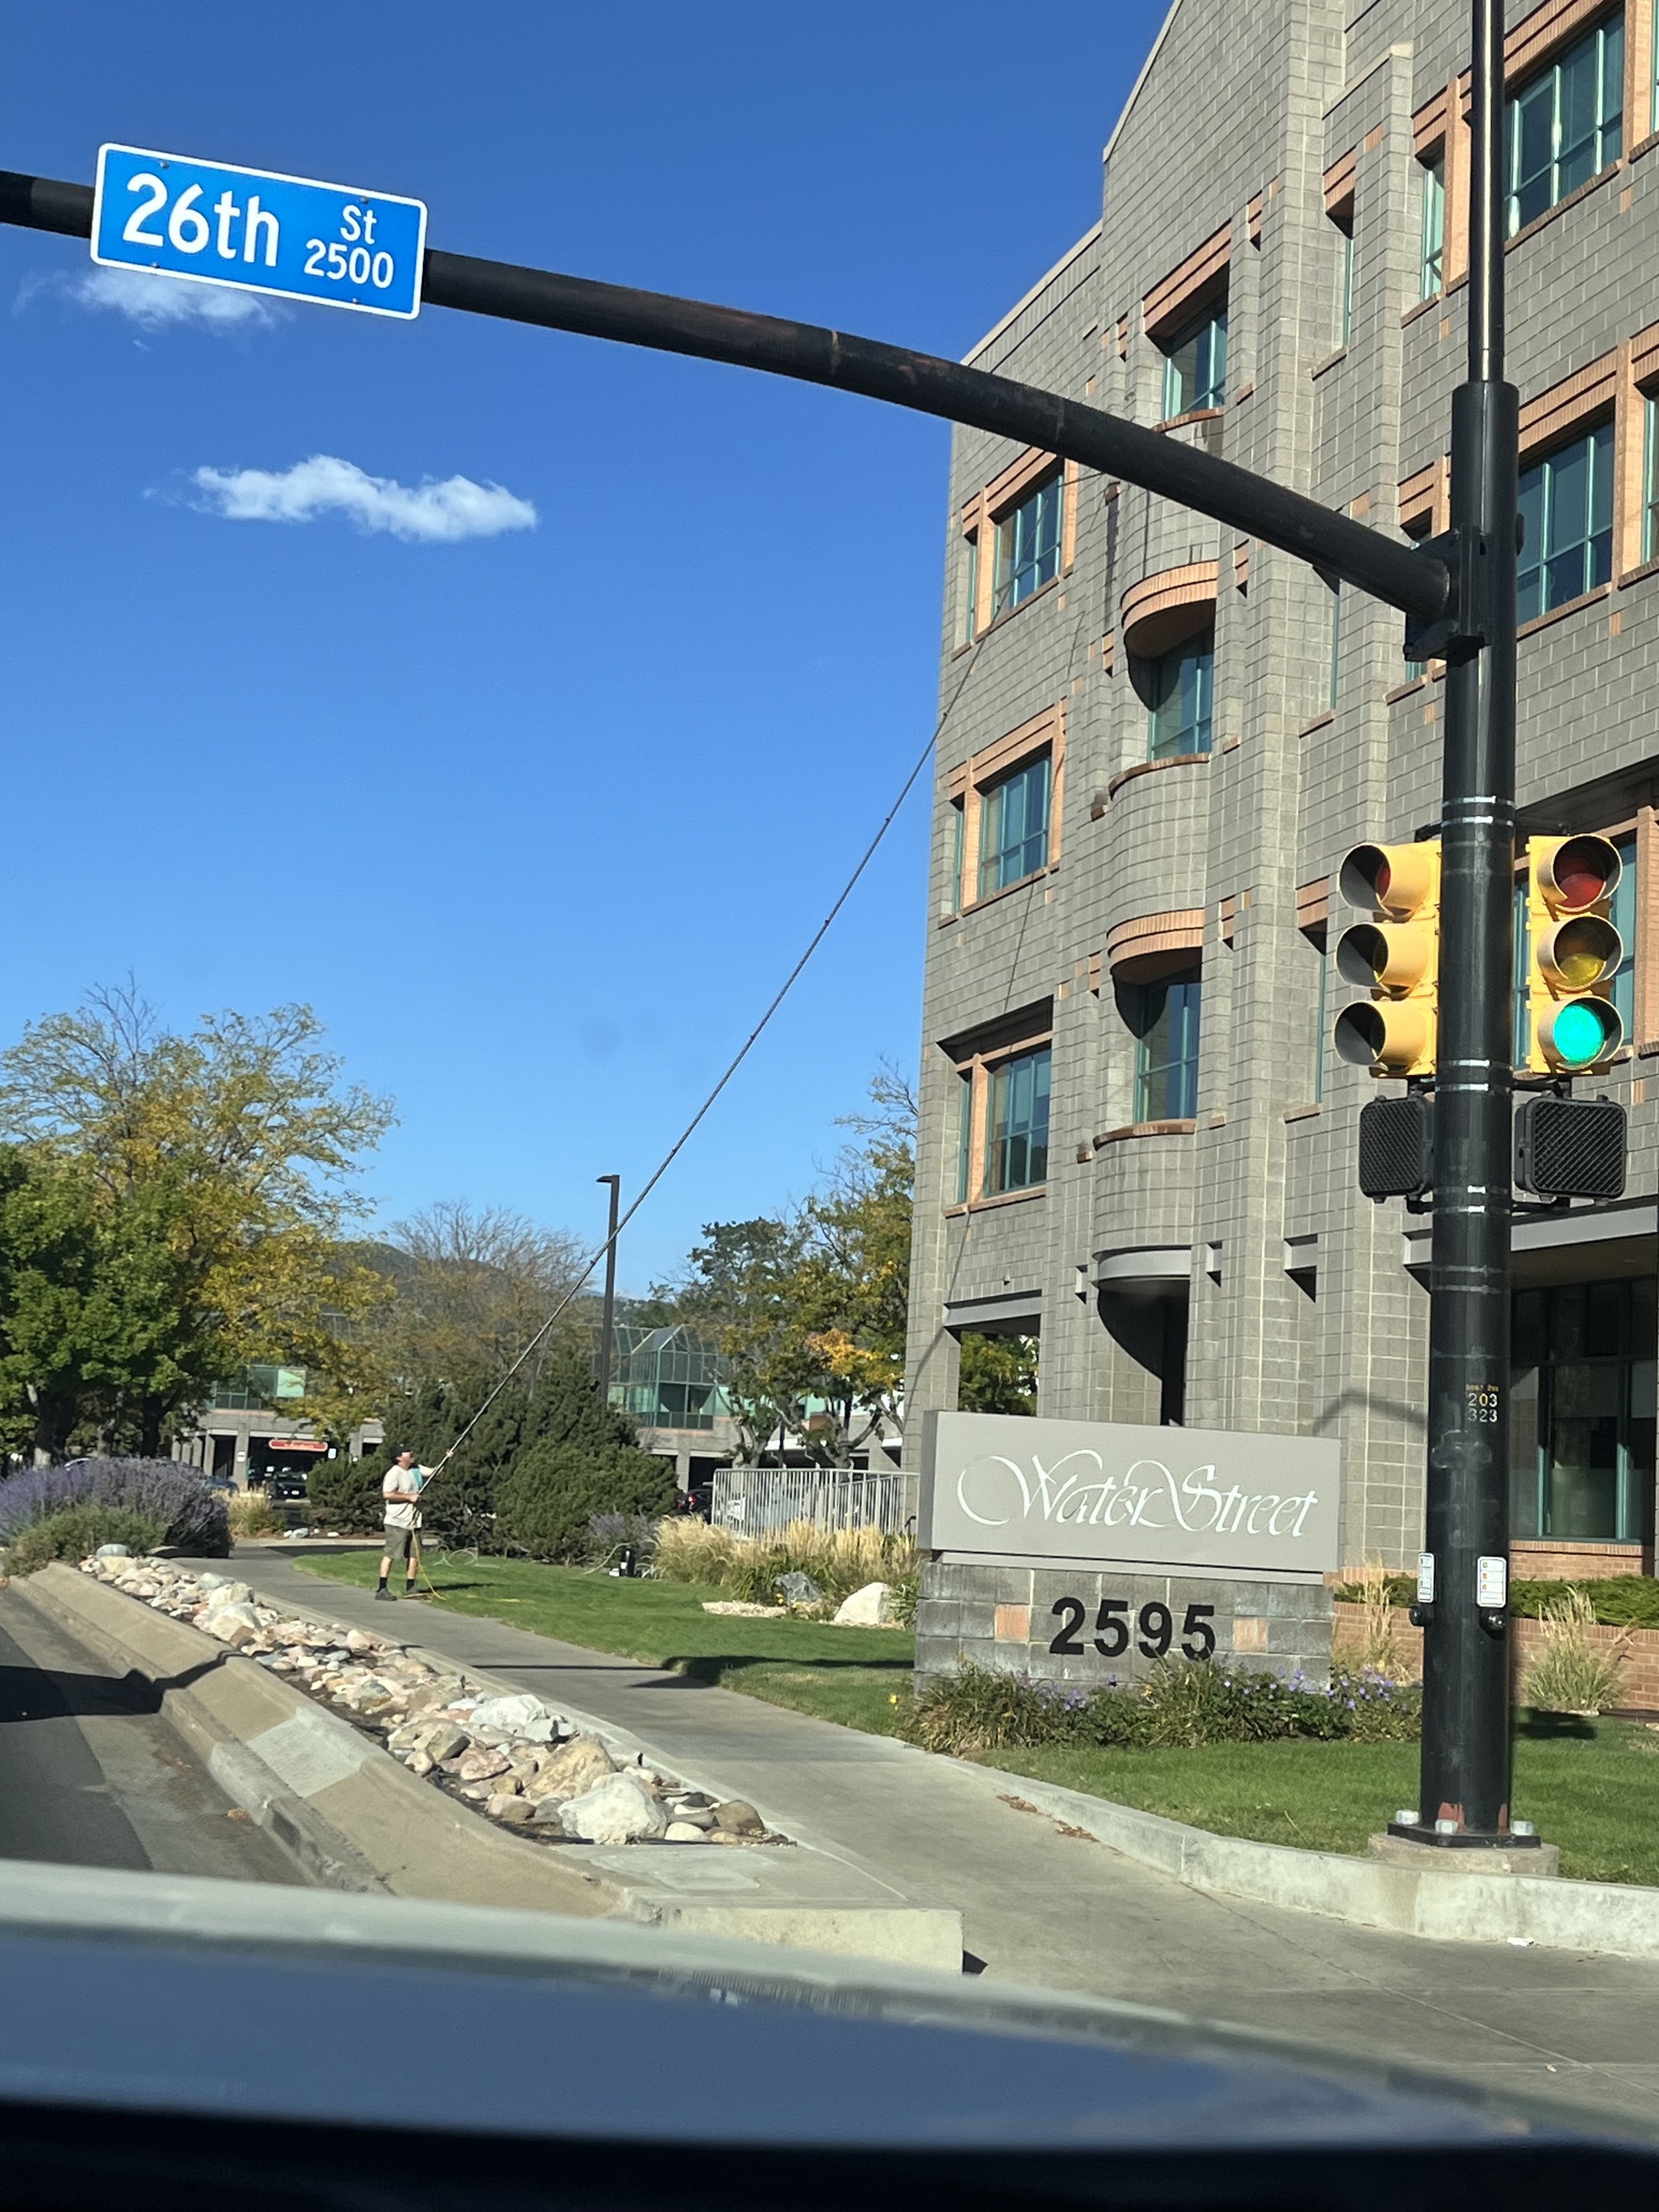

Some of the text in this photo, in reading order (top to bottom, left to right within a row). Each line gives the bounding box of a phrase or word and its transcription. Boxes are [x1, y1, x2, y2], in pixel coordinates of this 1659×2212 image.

[122, 173, 378, 267] 26th St
[303, 238, 394, 289] 2500
[1467, 1408, 1498, 1422] 323
[1468, 1392, 1498, 1408] 203
[957, 1449, 1318, 1537] Water Street
[1049, 1597, 1216, 1660] 2595
